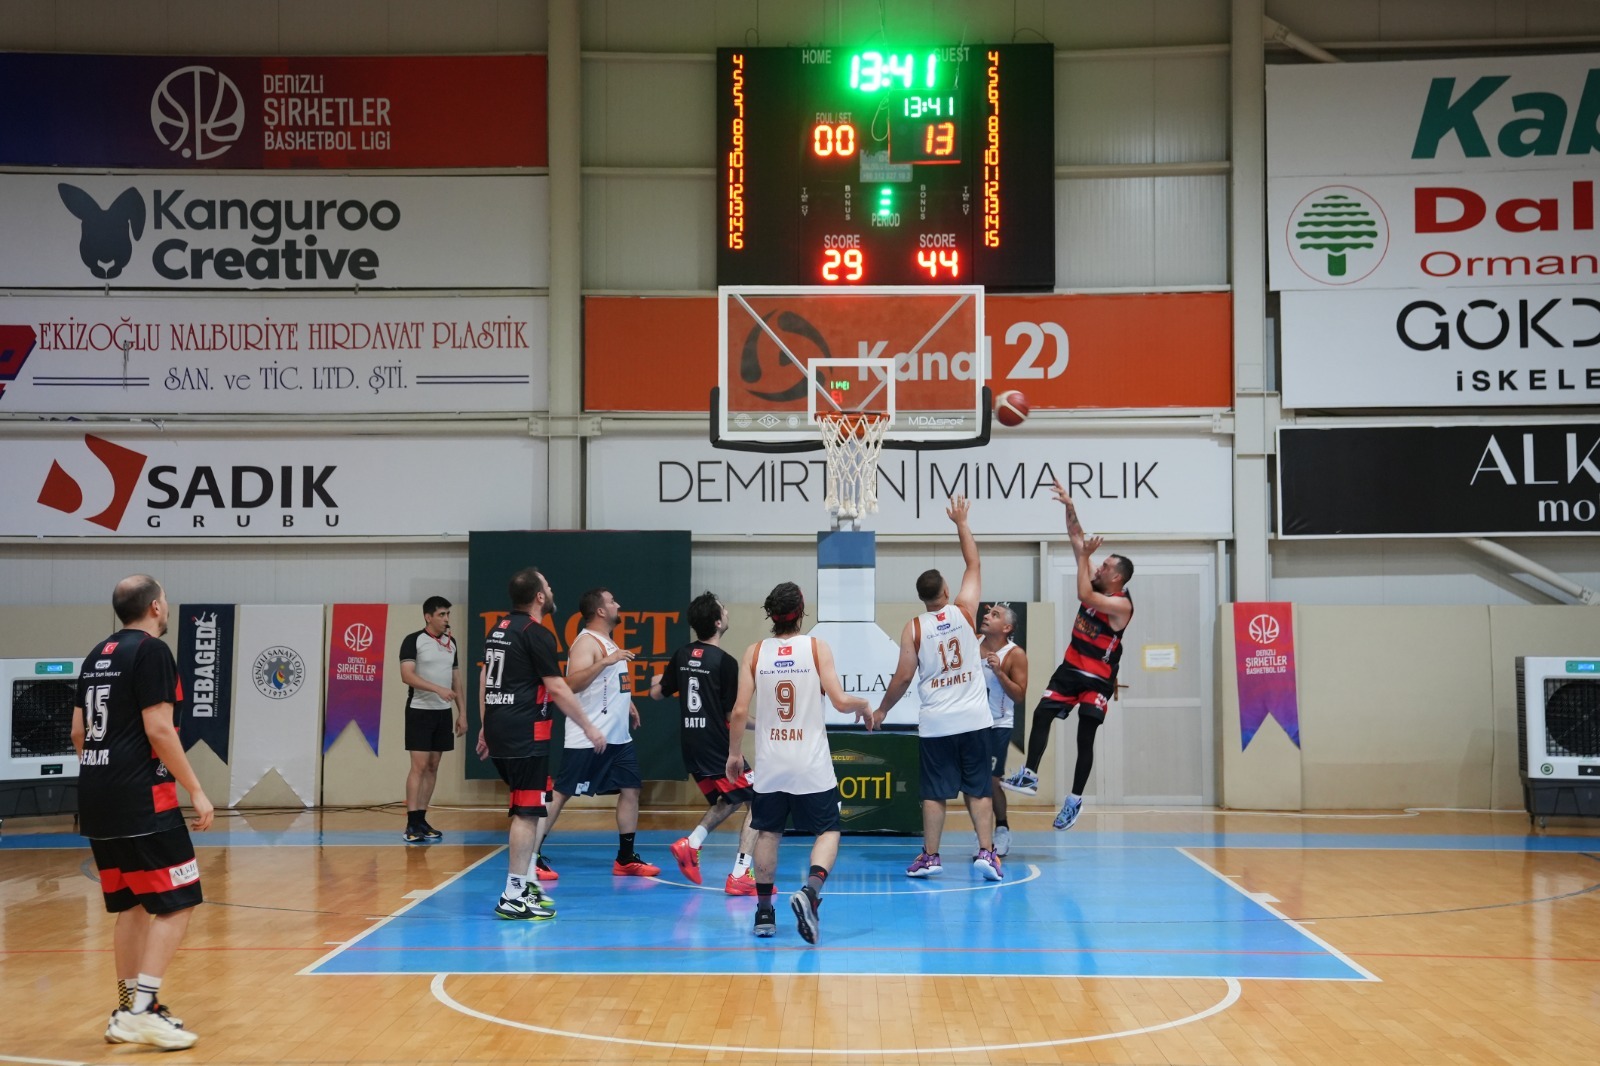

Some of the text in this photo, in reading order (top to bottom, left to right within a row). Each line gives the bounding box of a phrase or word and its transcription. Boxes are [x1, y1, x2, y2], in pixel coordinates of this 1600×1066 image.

[733, 54, 743, 69] 4
[802, 50, 832, 64] HOME
[933, 47, 970, 62] GUEST
[988, 51, 998, 66] 4
[733, 69, 743, 87] 5
[851, 51, 937, 92] 13:41
[988, 66, 998, 84] 5
[988, 83, 998, 100] 6
[733, 102, 743, 118] 7
[904, 96, 954, 118] 13:41
[988, 99, 998, 115] 7
[733, 118, 743, 135] 8
[816, 112, 834, 124] FOUL
[838, 112, 852, 124] SET
[988, 115, 998, 133] 8
[264, 131, 356, 150] BASKETBOL
[733, 135, 743, 151] 9
[814, 125, 854, 156] 00
[926, 122, 954, 155] 13
[988, 132, 998, 149] 9
[729, 151, 743, 168] 10
[984, 149, 999, 165] 10
[729, 168, 743, 183] 11
[984, 165, 999, 181] 11
[729, 183, 743, 200] 12
[984, 181, 999, 198] 12
[729, 200, 743, 216] 13
[984, 197, 999, 214] 13
[1414, 180, 1594, 234] Dal
[153, 189, 401, 246] Kanguroo
[729, 216, 743, 232] 14
[871, 213, 900, 227] PERIOD
[984, 214, 999, 230] 14
[729, 232, 743, 249] 15
[824, 235, 861, 248] SCORE
[919, 233, 956, 248] SCORE
[984, 230, 999, 247] 15
[151, 235, 379, 281] Creative
[822, 249, 863, 280] 29
[917, 250, 959, 278] 44
[1420, 251, 1598, 277] Orman
[38, 316, 530, 352] EKİZOĞLU NALBURİYE HIRDAVAT PLASTİK
[858, 335, 991, 382] Kanal
[164, 359, 407, 395] SAN. ve TİC. LTD. ŞTİ.
[147, 465, 338, 510] SADIK
[659, 460, 905, 503] DEMİRTN
[1538, 492, 1600, 522] mo
[147, 514, 339, 529] GRUBU
[938, 636, 963, 674] 13
[485, 648, 505, 688] 27
[841, 673, 895, 692] LLA
[931, 671, 972, 688] MEHMET
[687, 676, 703, 713] 6
[775, 680, 796, 722] 9
[85, 684, 111, 741] 15
[684, 717, 706, 728] BATU
[770, 728, 803, 741] ERSAN
[836, 771, 891, 799] OTTI
